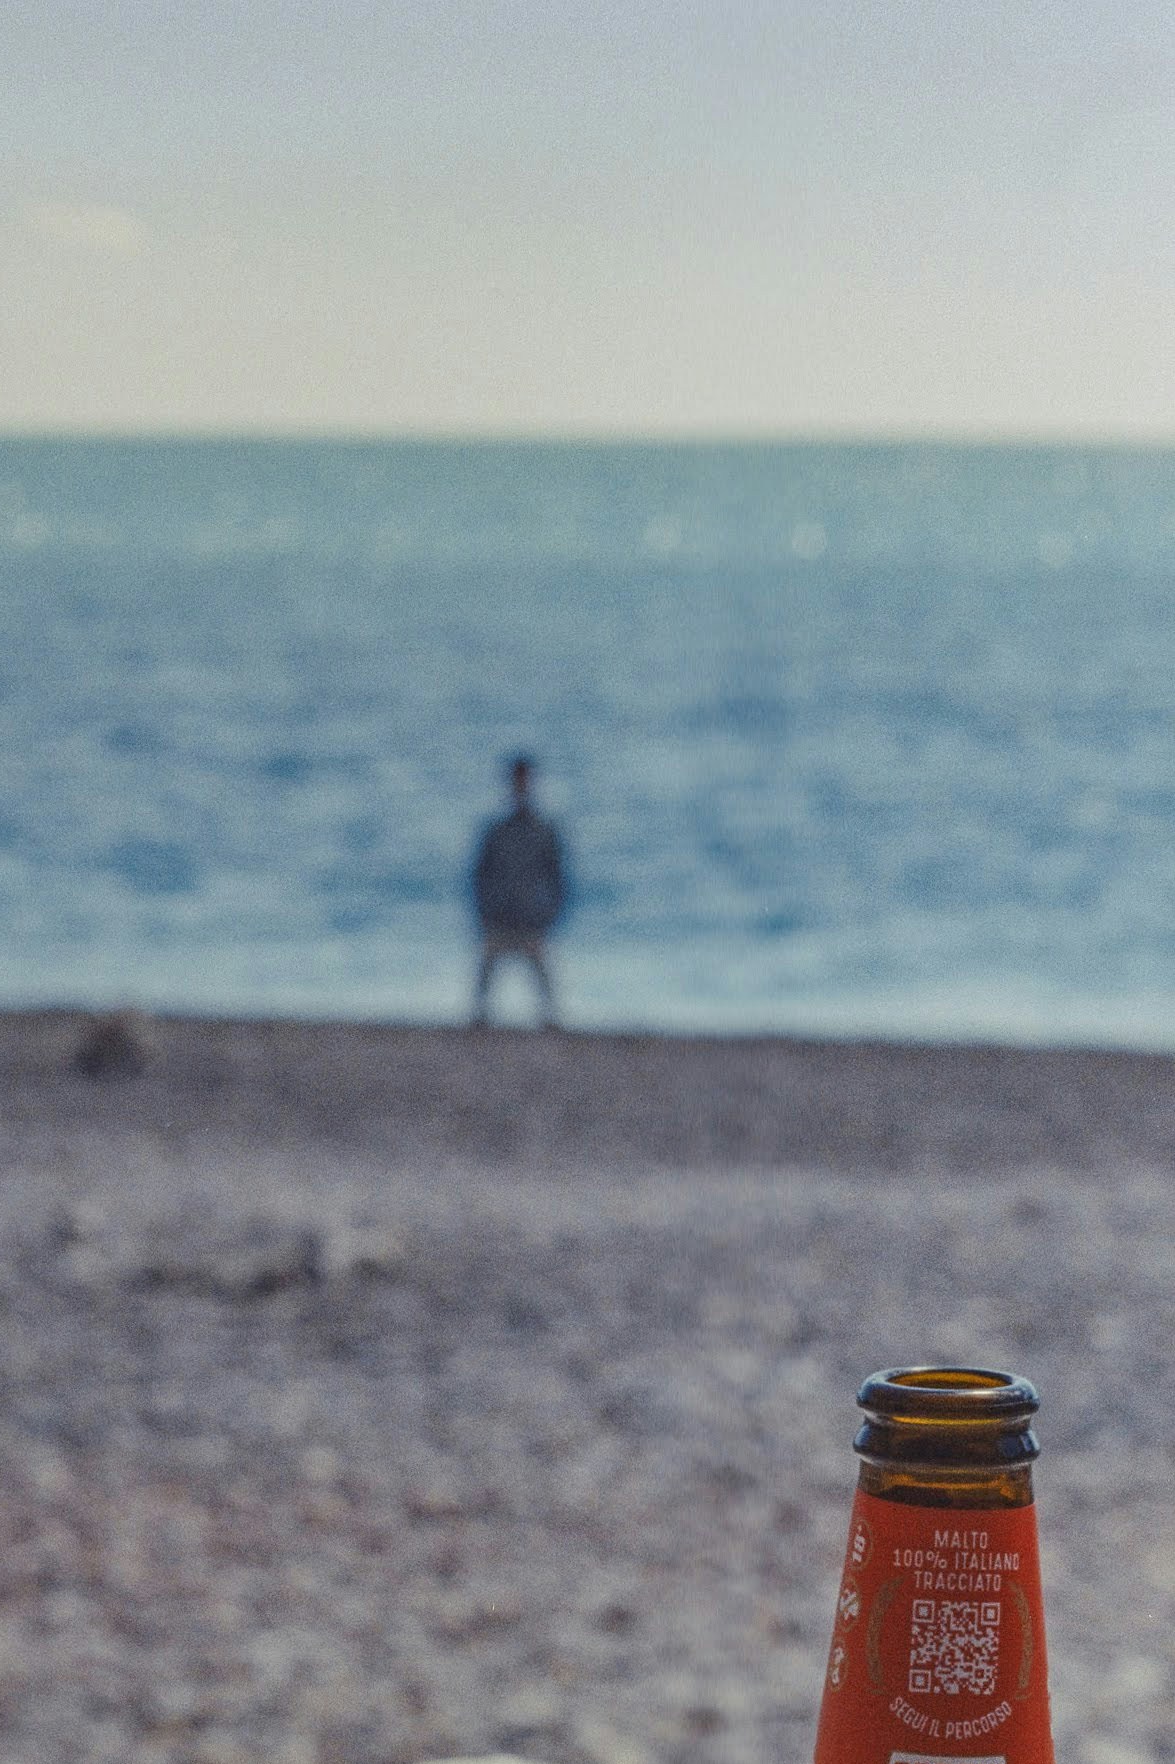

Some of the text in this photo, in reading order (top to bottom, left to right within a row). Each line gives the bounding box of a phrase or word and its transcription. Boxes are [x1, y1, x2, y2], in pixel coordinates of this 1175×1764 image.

[934, 1530, 989, 1550] MALTO
[892, 1549, 1021, 1572] 100% ITALIANO
[914, 1571, 1002, 1592] TRACCIATO
[889, 1697, 1013, 1741] SEGUI IL PERCORSO
